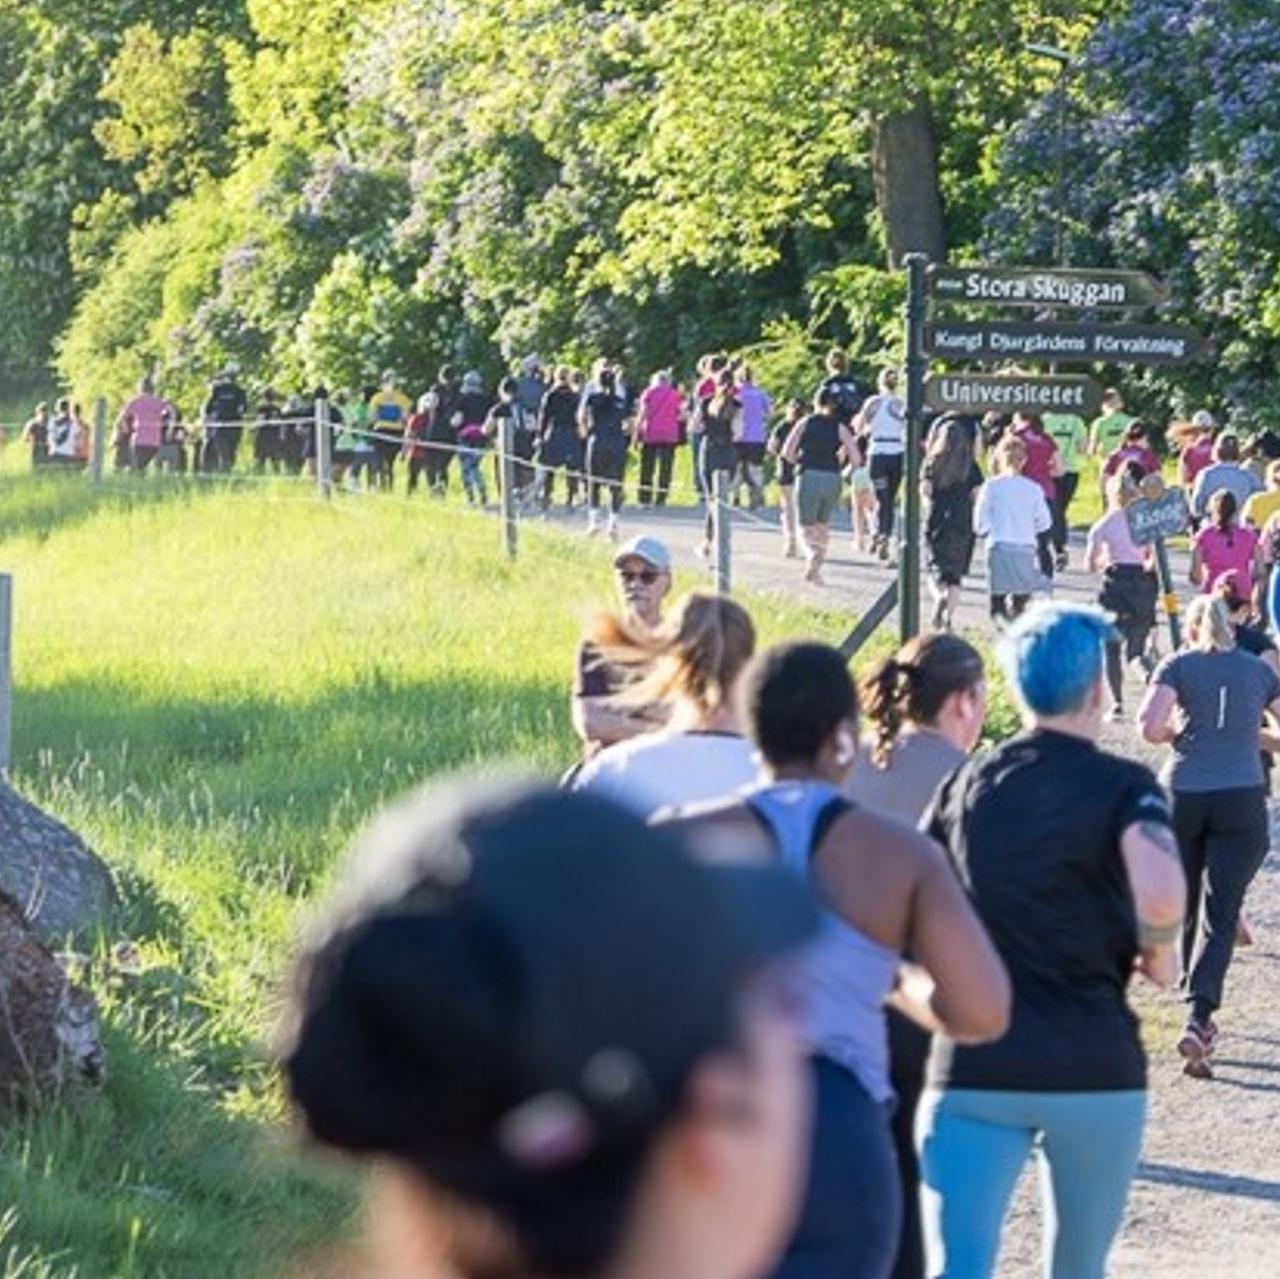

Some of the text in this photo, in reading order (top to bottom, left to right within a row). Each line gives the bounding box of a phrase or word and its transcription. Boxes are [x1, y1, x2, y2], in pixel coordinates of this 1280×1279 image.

[965, 273, 1125, 306] Stora Skuggan
[990, 332, 1085, 353] Djurgårdens
[1094, 335, 1184, 357] Förvaltning
[940, 380, 1085, 405] Universitetet
